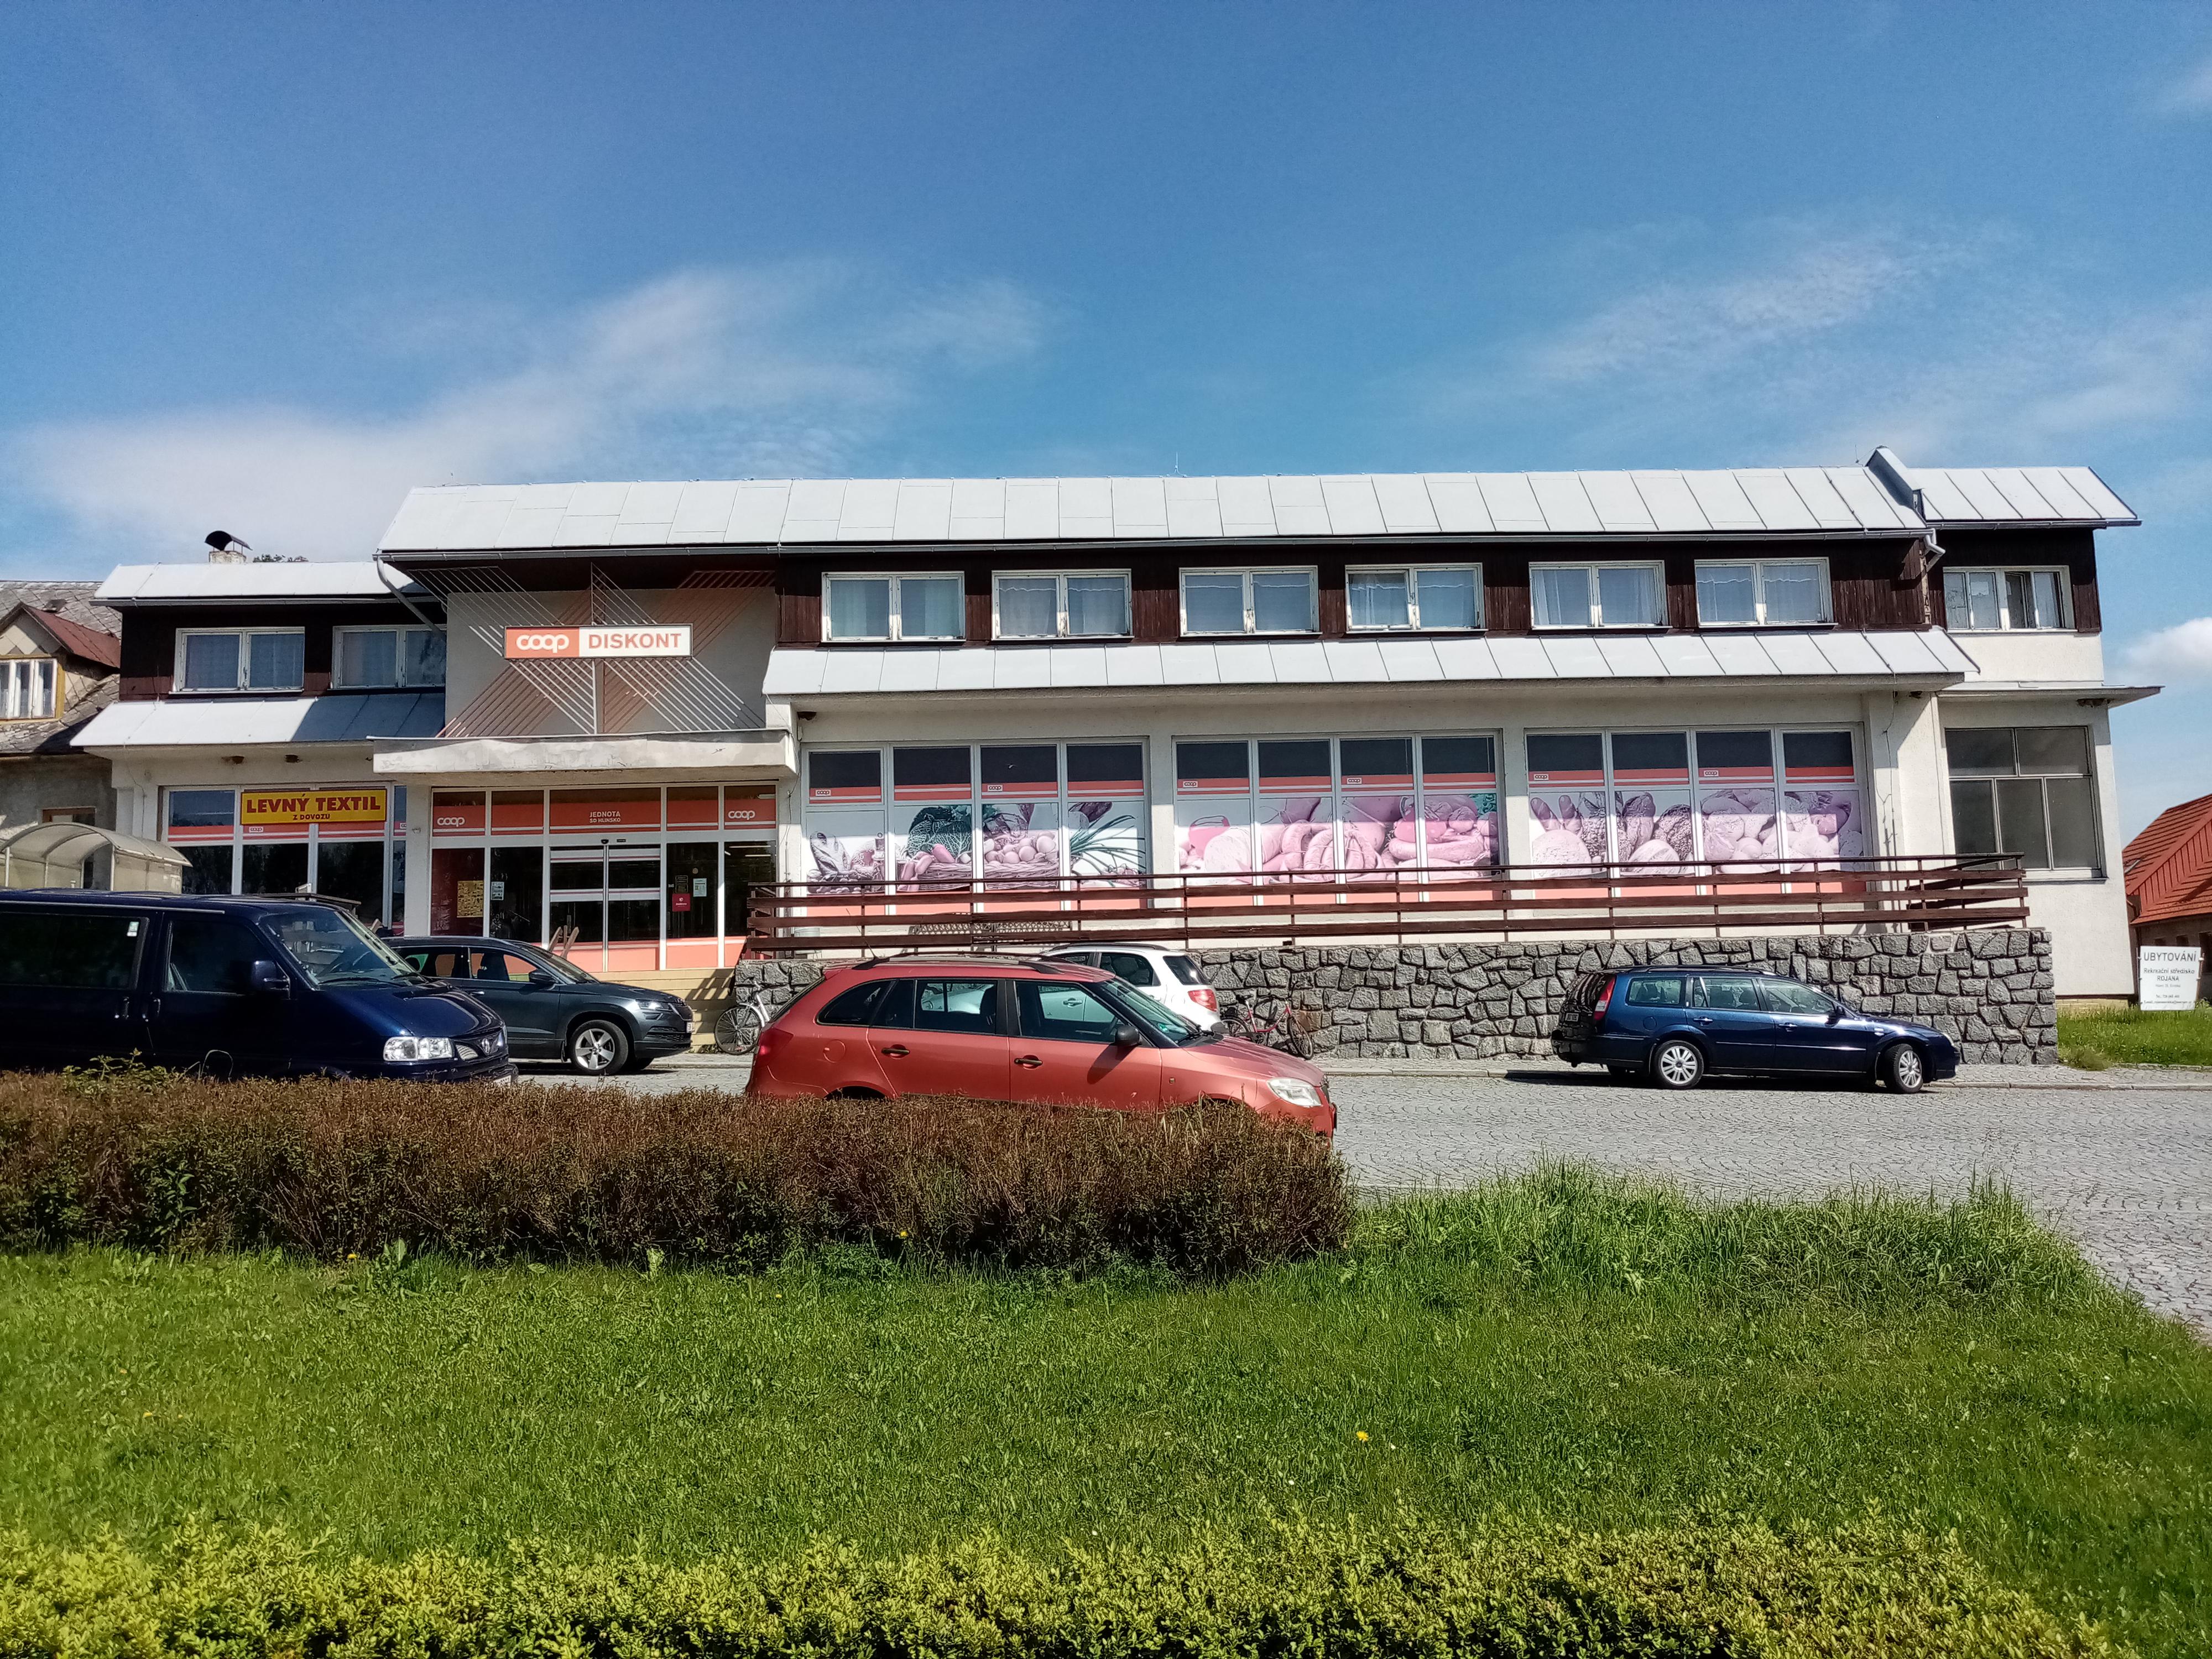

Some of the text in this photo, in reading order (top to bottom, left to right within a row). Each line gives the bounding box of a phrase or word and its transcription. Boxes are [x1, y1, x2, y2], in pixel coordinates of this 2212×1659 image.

[588, 633, 681, 649] DISKONT
[247, 794, 381, 813] LEVNÝ TEXTIL
[2143, 951, 2197, 962] UBYTOVÁNÍ
